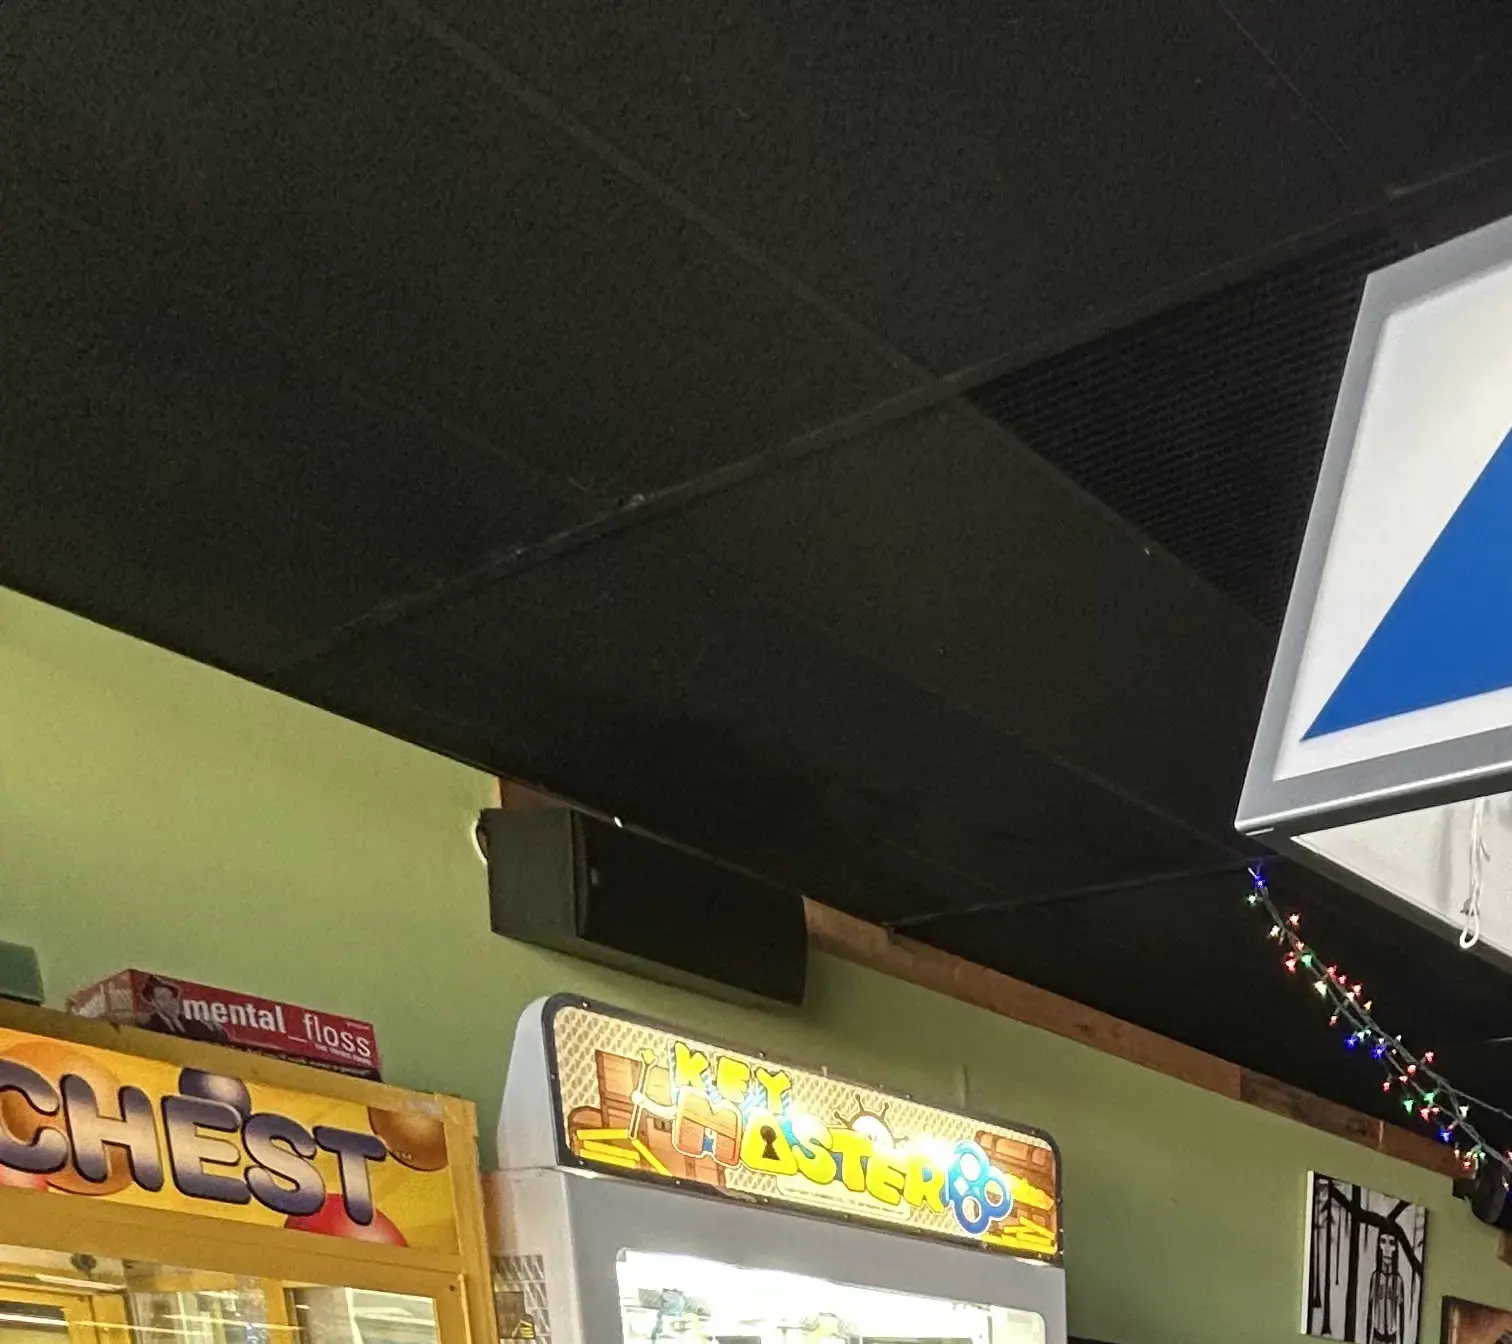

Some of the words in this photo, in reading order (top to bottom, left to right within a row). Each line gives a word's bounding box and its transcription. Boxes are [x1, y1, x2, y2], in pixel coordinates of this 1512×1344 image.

[672, 1041, 792, 1113] KEY
[0, 1058, 388, 1226] CHEST
[671, 1092, 946, 1213] MASTER
